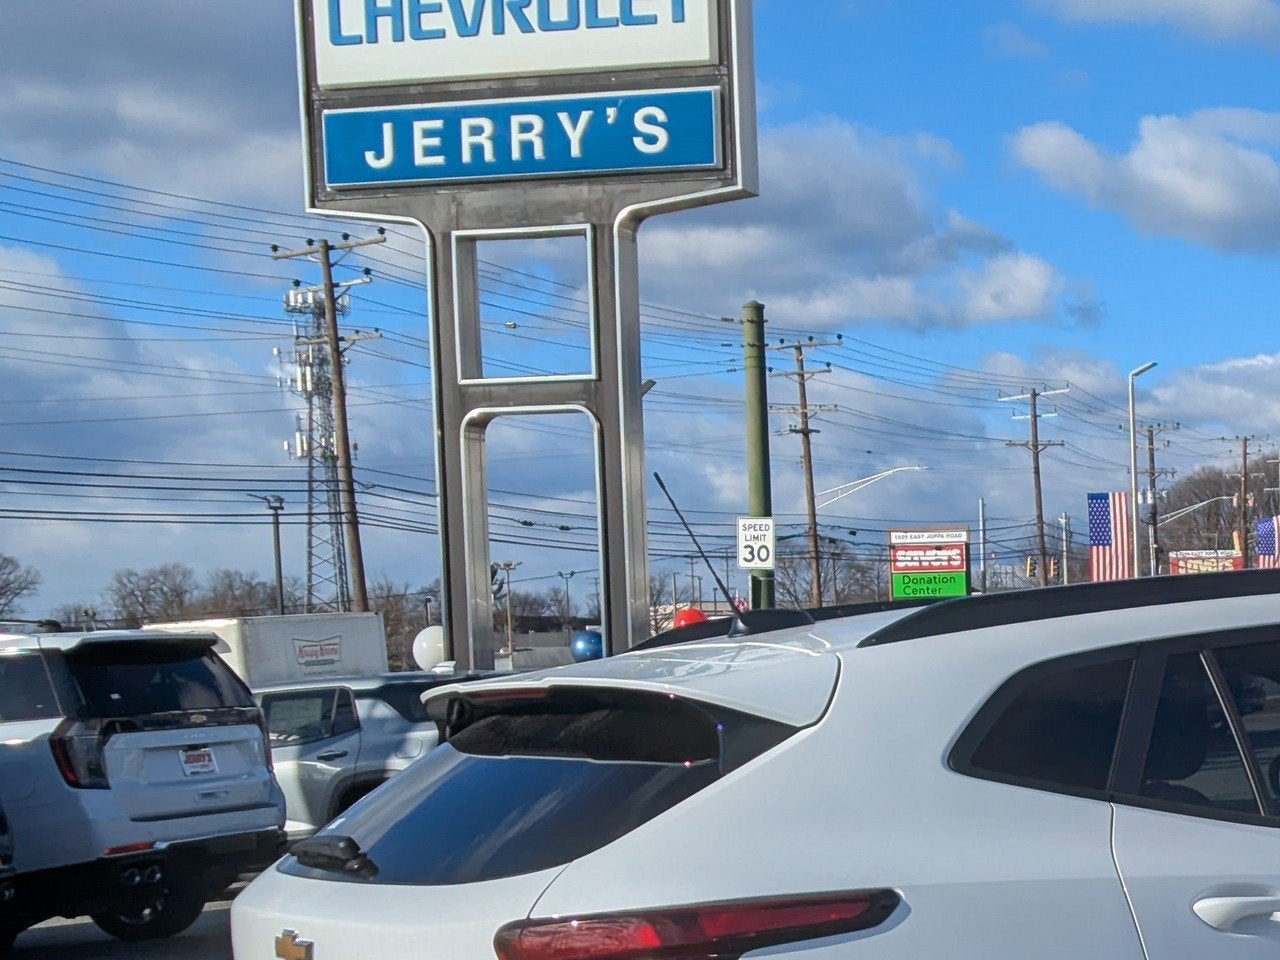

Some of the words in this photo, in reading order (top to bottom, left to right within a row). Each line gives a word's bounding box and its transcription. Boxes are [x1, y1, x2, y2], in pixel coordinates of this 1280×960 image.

[364, 106, 670, 170] JERRY'S
[742, 523, 771, 532] SPEED
[744, 533, 767, 541] LIMIT
[742, 544, 770, 563] 30
[902, 573, 956, 585] Donation
[903, 585, 943, 596] Center
